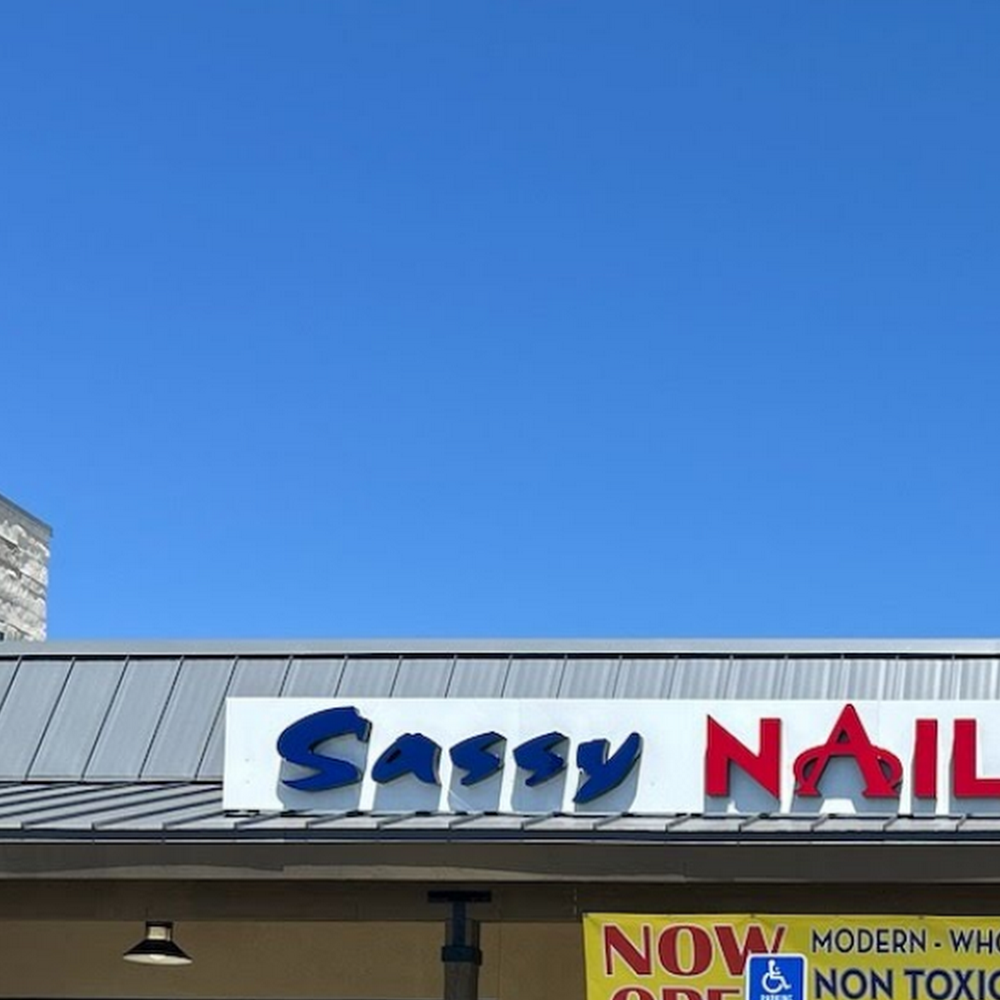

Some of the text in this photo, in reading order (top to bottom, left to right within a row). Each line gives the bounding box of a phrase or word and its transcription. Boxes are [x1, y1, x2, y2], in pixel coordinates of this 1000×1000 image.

[276, 706, 640, 803] Sassy
[602, 923, 786, 976] NOW
[812, 928, 926, 953] MODERN
[814, 969, 894, 1000] NON
